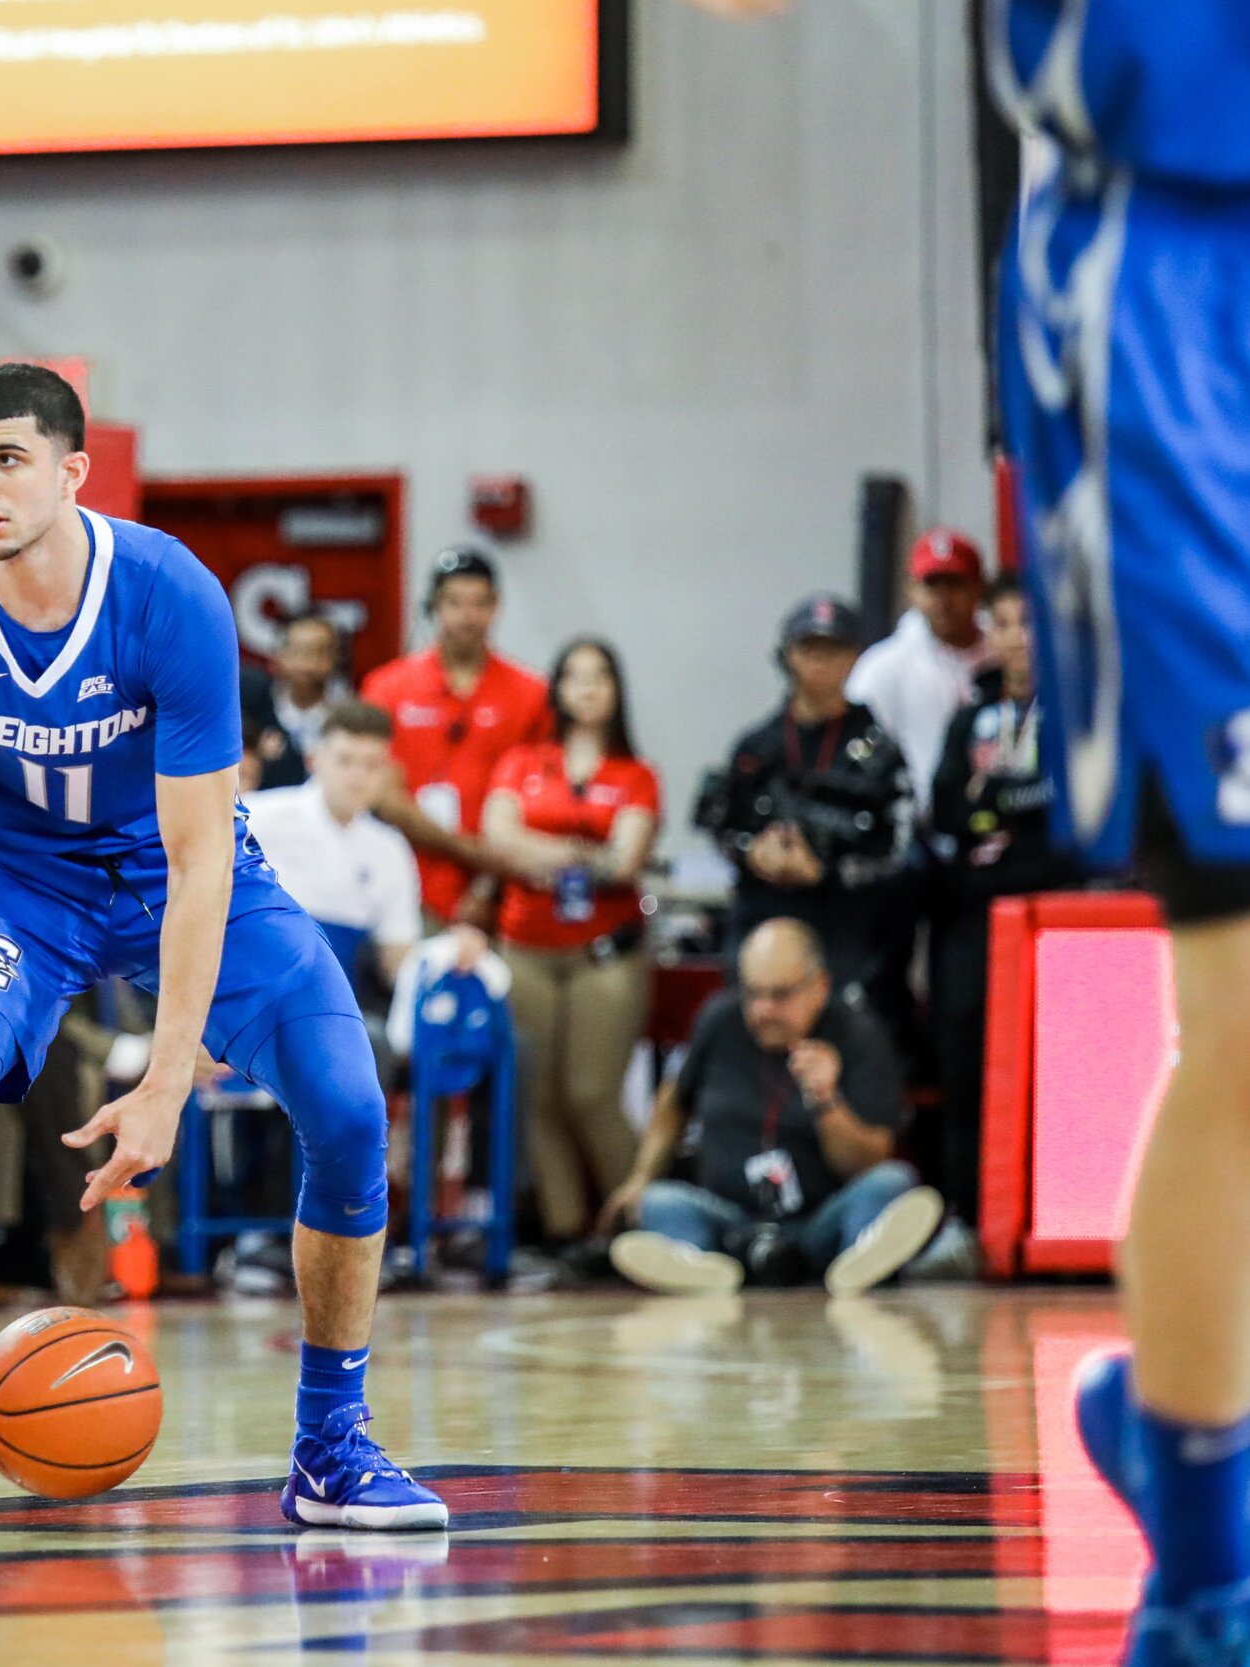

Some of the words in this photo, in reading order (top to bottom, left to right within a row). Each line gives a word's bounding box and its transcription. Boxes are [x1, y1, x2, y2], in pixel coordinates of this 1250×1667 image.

[80, 675, 107, 687] BIG
[78, 683, 115, 698] EAST
[17, 757, 93, 825] 11
